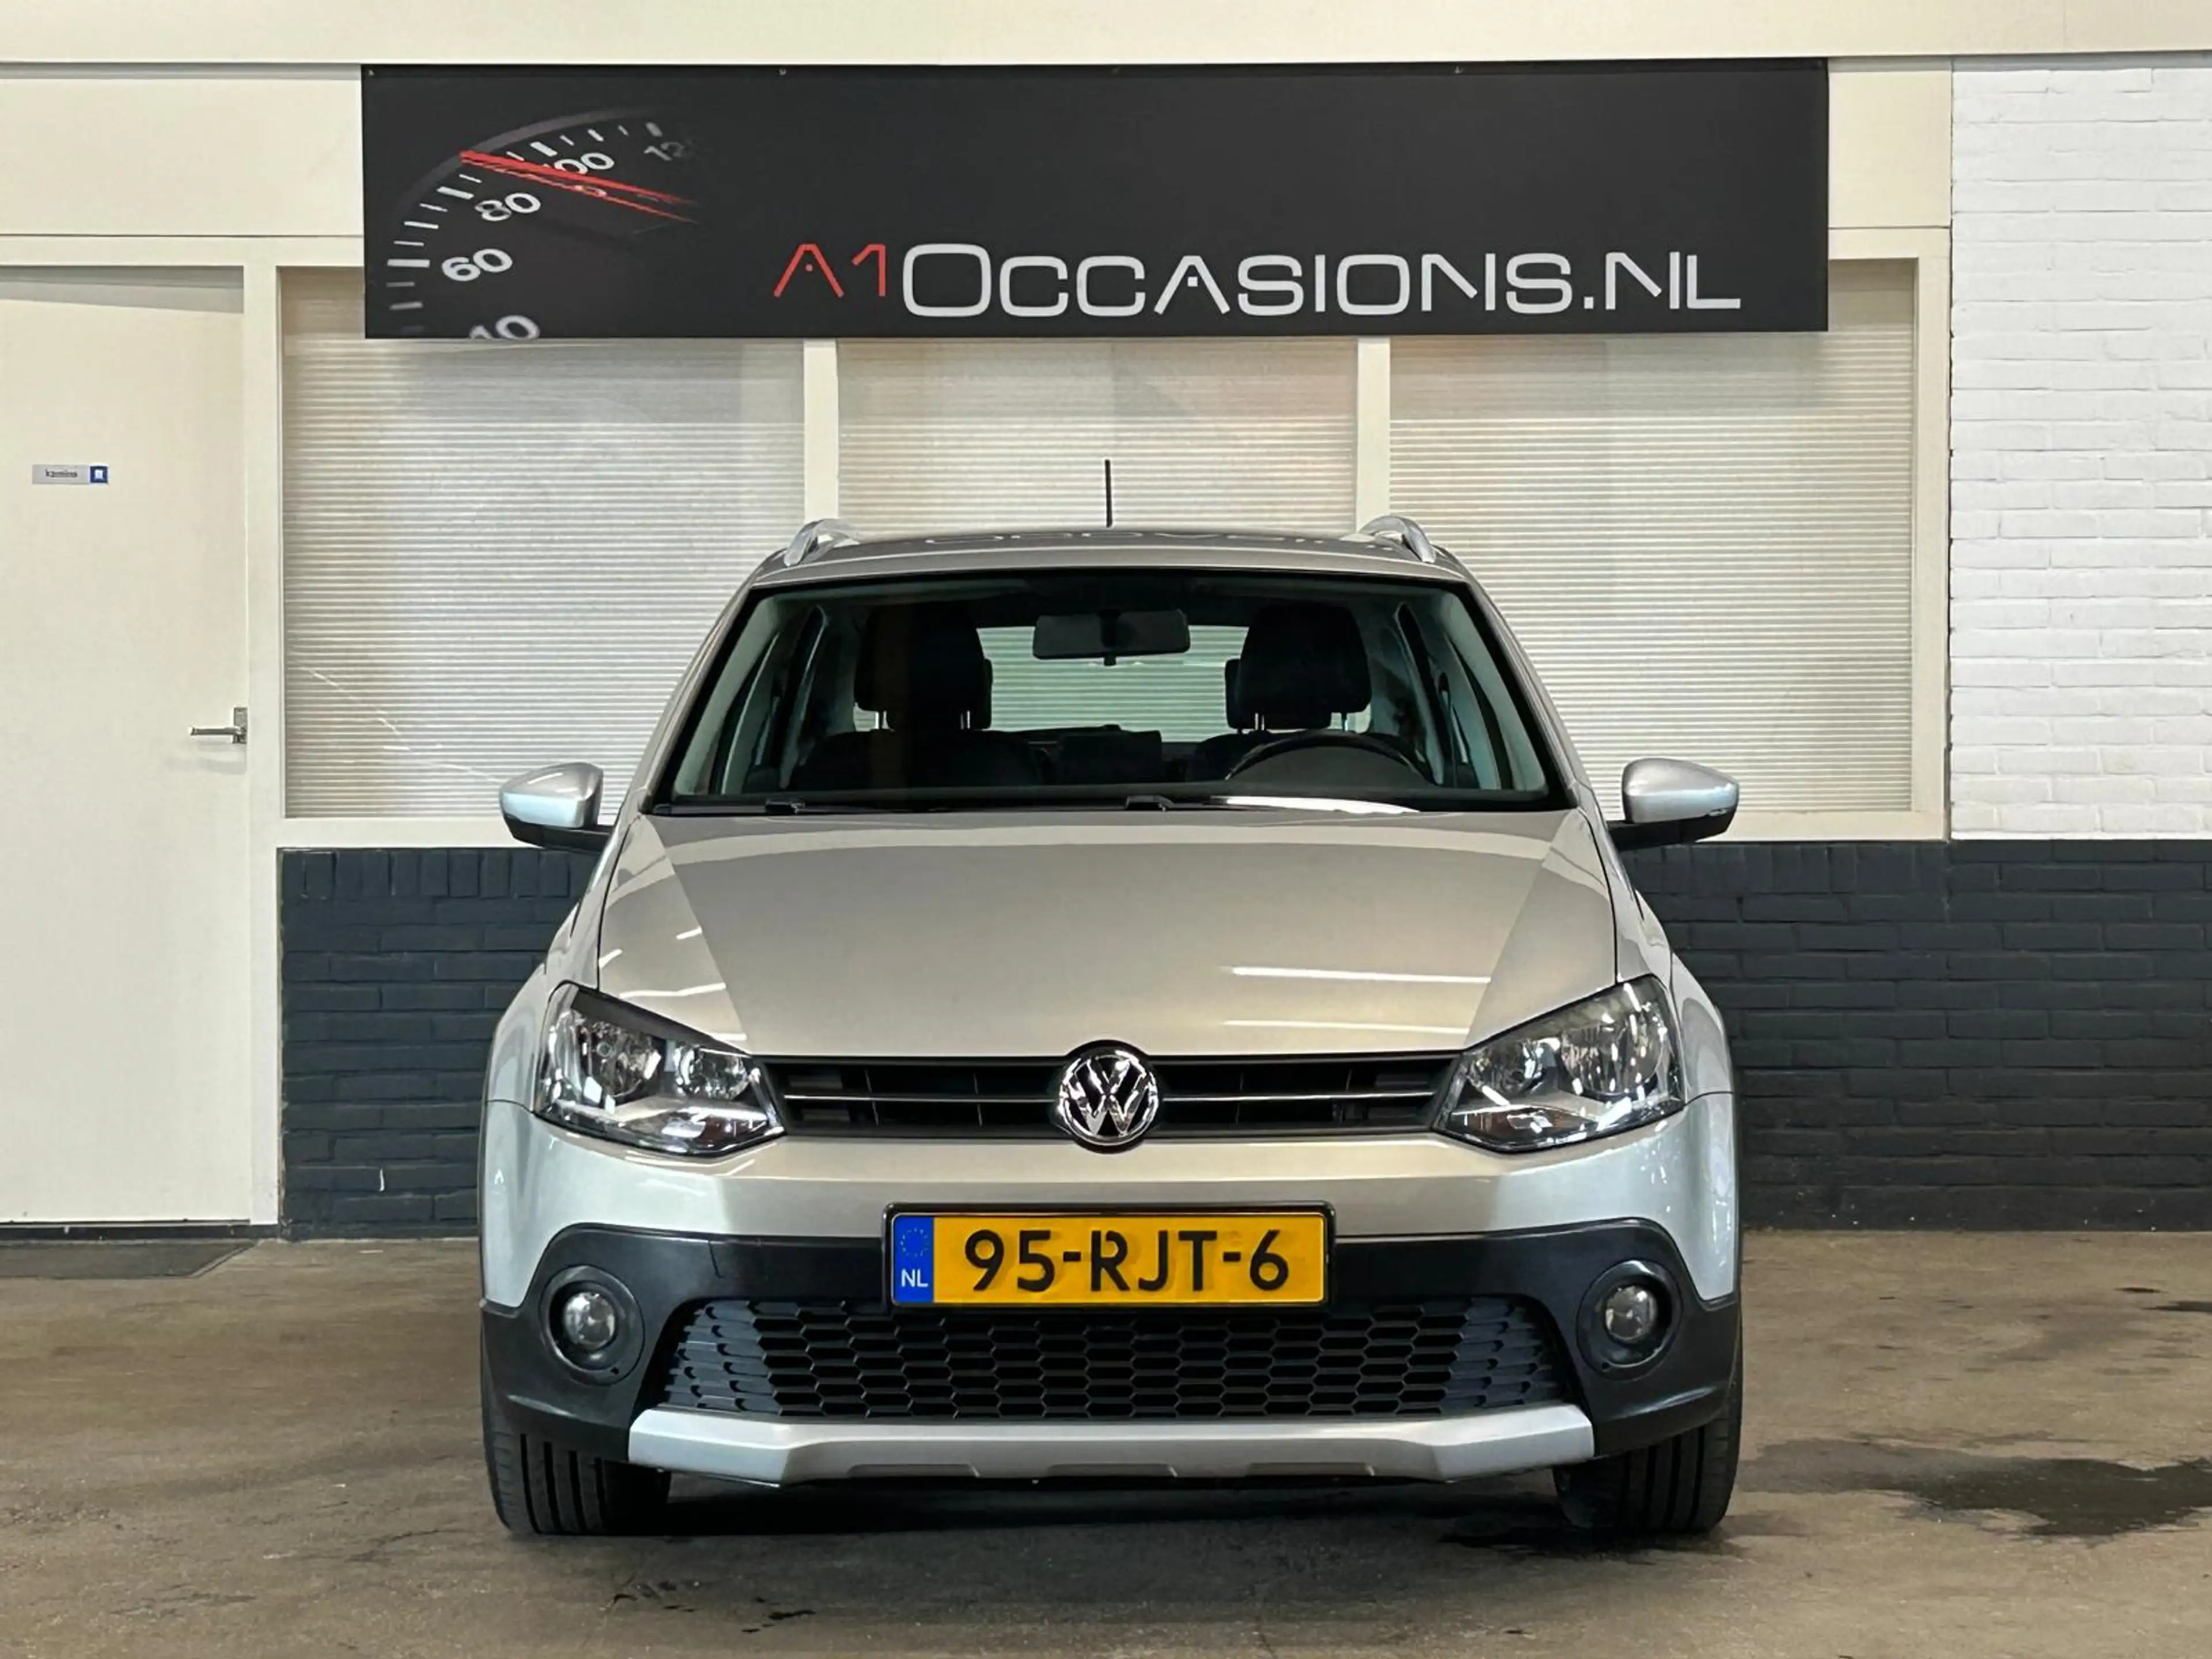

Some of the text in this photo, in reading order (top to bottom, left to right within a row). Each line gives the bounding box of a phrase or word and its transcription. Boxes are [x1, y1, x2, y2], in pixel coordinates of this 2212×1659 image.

[543, 152, 615, 175] 00
[474, 192, 541, 222] 80
[441, 248, 513, 282] 60
[964, 1228, 1289, 1293] 95-RJT-6
[901, 1268, 929, 1288] NL
